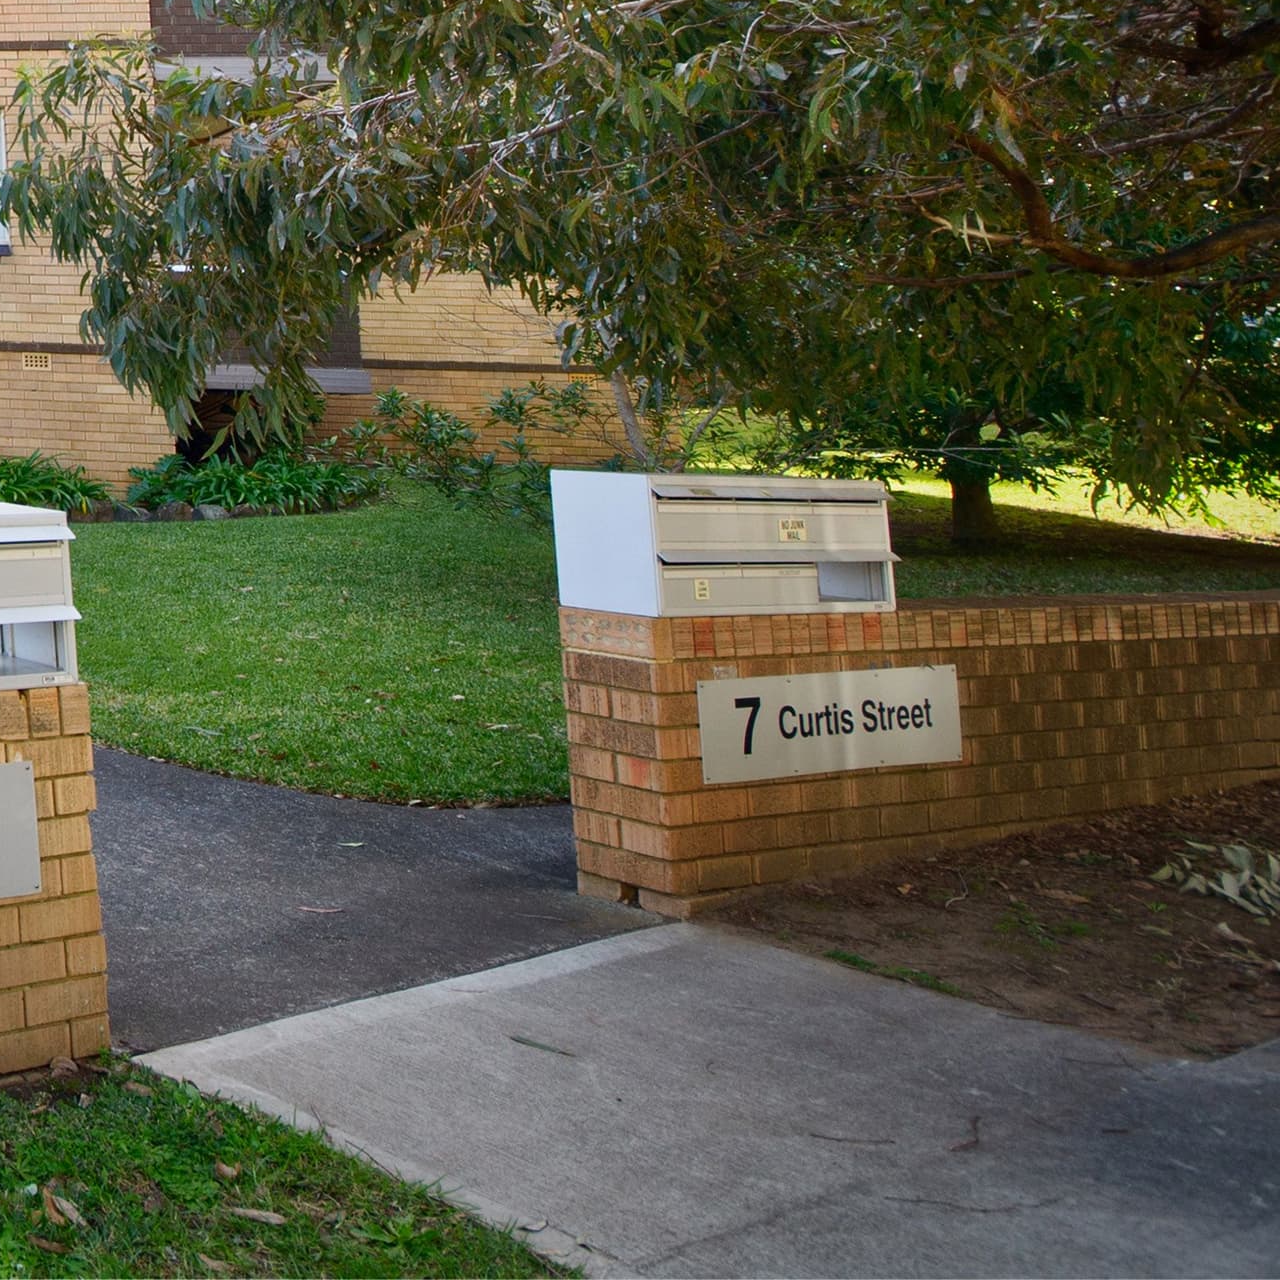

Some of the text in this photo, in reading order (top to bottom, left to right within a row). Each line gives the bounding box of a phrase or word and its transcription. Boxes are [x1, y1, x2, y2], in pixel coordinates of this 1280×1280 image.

[734, 696, 933, 755] 7 Curtis Street
